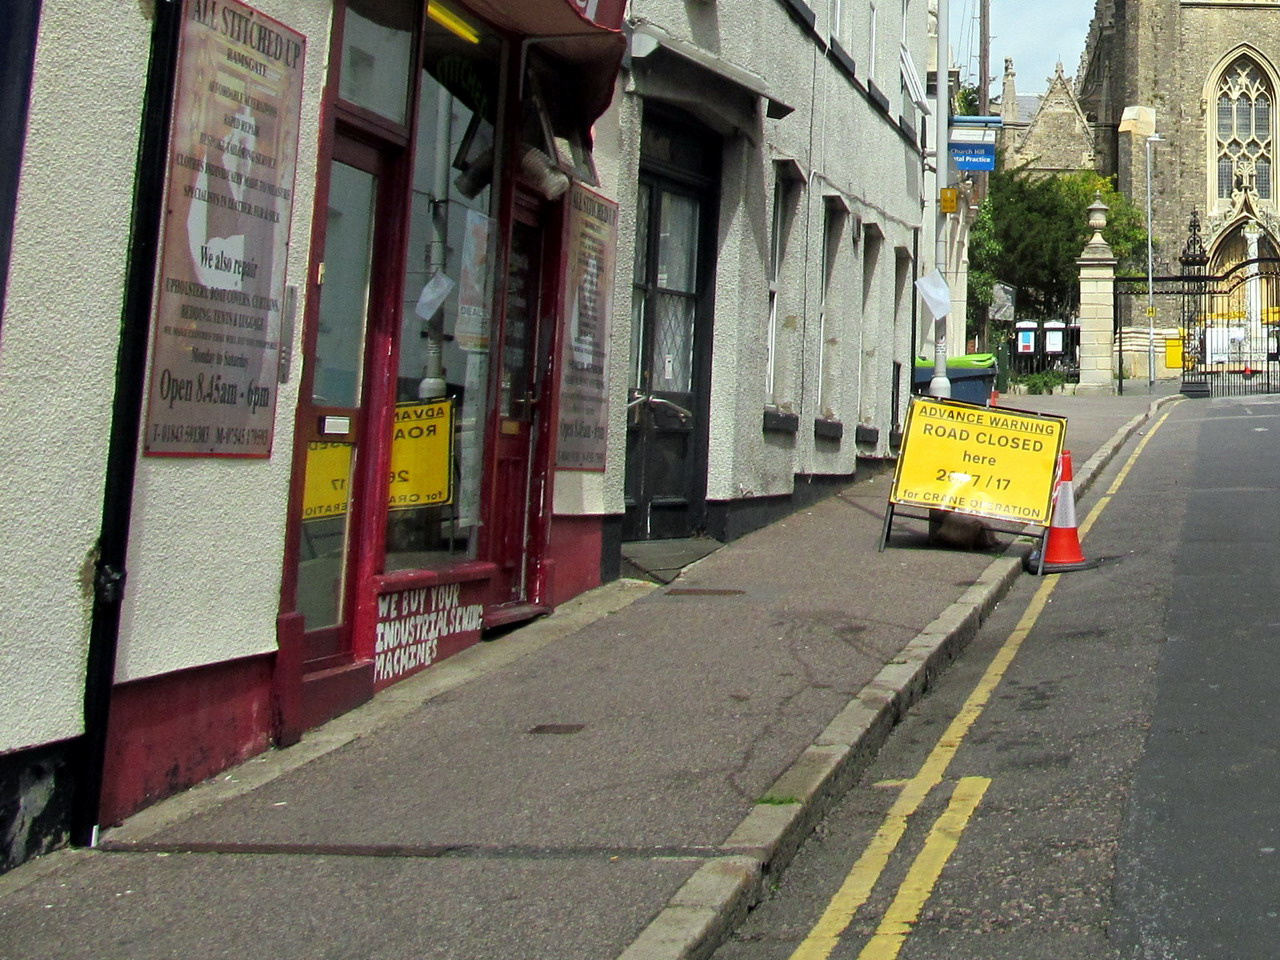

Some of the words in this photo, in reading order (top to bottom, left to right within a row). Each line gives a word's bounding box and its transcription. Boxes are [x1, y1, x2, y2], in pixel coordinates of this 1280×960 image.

[221, 6, 282, 60] STITCHED
[286, 38, 300, 69] UP
[200, 245, 213, 269] We
[214, 250, 232, 273] also
[233, 257, 258, 282] repair
[191, 346, 215, 366] Monday
[223, 350, 249, 369] Saturday
[160, 368, 193, 409] Open
[197, 372, 237, 405] 8.45am
[247, 378, 269, 414] 6pm
[919, 404, 984, 425] ADVANCE
[988, 415, 1055, 436] WARNING
[922, 423, 970, 441] ROAD
[976, 431, 1044, 452] CLOSED
[962, 450, 997, 466] here
[903, 489, 918, 499] for
[923, 492, 965, 507] CRANE
[377, 592, 399, 619] WE
[402, 588, 427, 615] BUY
[431, 583, 460, 612] YOUR
[375, 609, 449, 653] INDUSTRIAL
[449, 604, 483, 634] SEWING
[374, 638, 438, 684] MACHINES
